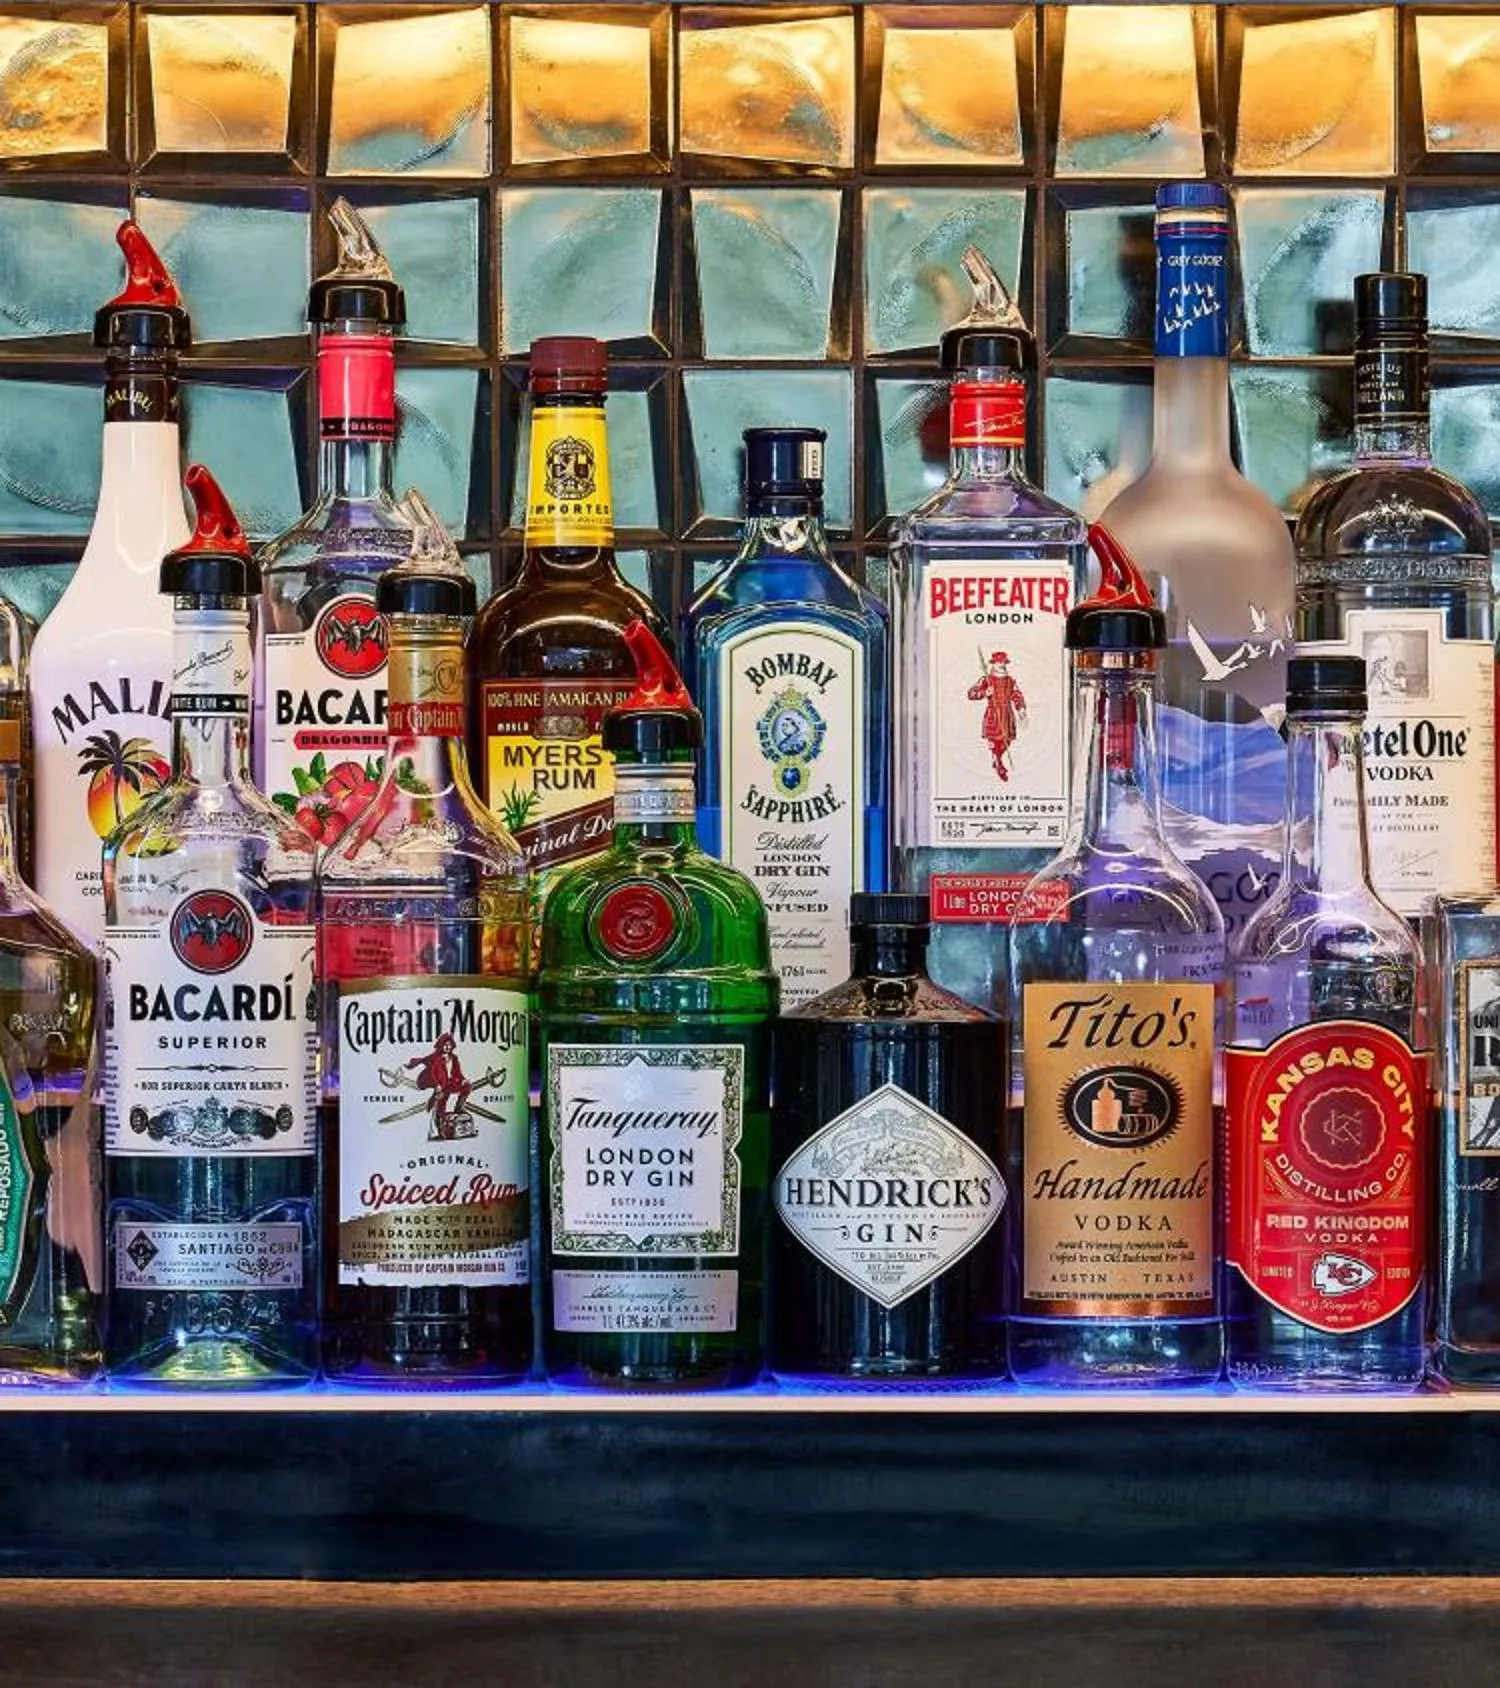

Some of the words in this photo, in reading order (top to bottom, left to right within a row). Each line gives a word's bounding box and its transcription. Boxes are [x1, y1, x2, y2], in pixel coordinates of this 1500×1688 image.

[530, 504, 611, 515] IMPORTED
[929, 576, 1070, 620] BEEFEATER
[965, 612, 1033, 625] LONDON
[744, 652, 838, 695] BOMBAY
[276, 689, 389, 725] BACAR
[515, 692, 541, 708] FINE
[53, 677, 175, 745] MALI
[1362, 719, 1409, 758] etel
[1413, 719, 1468, 758] One
[533, 767, 596, 790] RUM
[1366, 766, 1434, 781] VODKA
[740, 783, 843, 823] SAPPHIRE
[936, 804, 956, 813] THE
[961, 804, 996, 813] HEART
[999, 804, 1014, 813] OF
[1017, 804, 1064, 813] LONDON
[1404, 795, 1449, 807] MADE
[755, 830, 830, 851] Distilled
[763, 853, 822, 863] LONDON
[754, 865, 793, 877] DRY
[795, 865, 830, 877] GIN
[764, 903, 829, 913] NFUSED
[969, 903, 1000, 915] DRY
[129, 973, 296, 1021] BACARDÍ
[343, 998, 438, 1053] Captain
[443, 998, 527, 1051] Morgan
[158, 1036, 268, 1049] SUPERIOR
[162, 1083, 209, 1092] SUPERIOR
[1260, 1046, 1376, 1144] KANSAS
[1382, 1065, 1416, 1141] CITY
[566, 1097, 722, 1139] Tanqueray
[407, 1155, 485, 1169] ORIGINAL
[585, 1147, 695, 1165] LONDON
[585, 1170, 636, 1187] DRY
[647, 1170, 695, 1187] GIN
[1030, 1159, 1209, 1201] Handmade
[1274, 1152, 1383, 1204] DISTILLING
[360, 1174, 460, 1210] Spiced
[461, 1174, 519, 1210] Rum
[785, 1178, 991, 1208] HENDRICK'S
[1074, 1215, 1173, 1232] VODKA
[1265, 1214, 1308, 1230] RED
[1314, 1214, 1410, 1230] KINGDOM
[367, 1228, 461, 1239] MADAGASCAR
[857, 1222, 923, 1243] GIN
[1304, 1232, 1379, 1243] VODKA
[178, 1243, 255, 1255] SANTIAGO
[1050, 1273, 1107, 1283] AUSTIN
[1143, 1273, 1197, 1283] TEXAS
